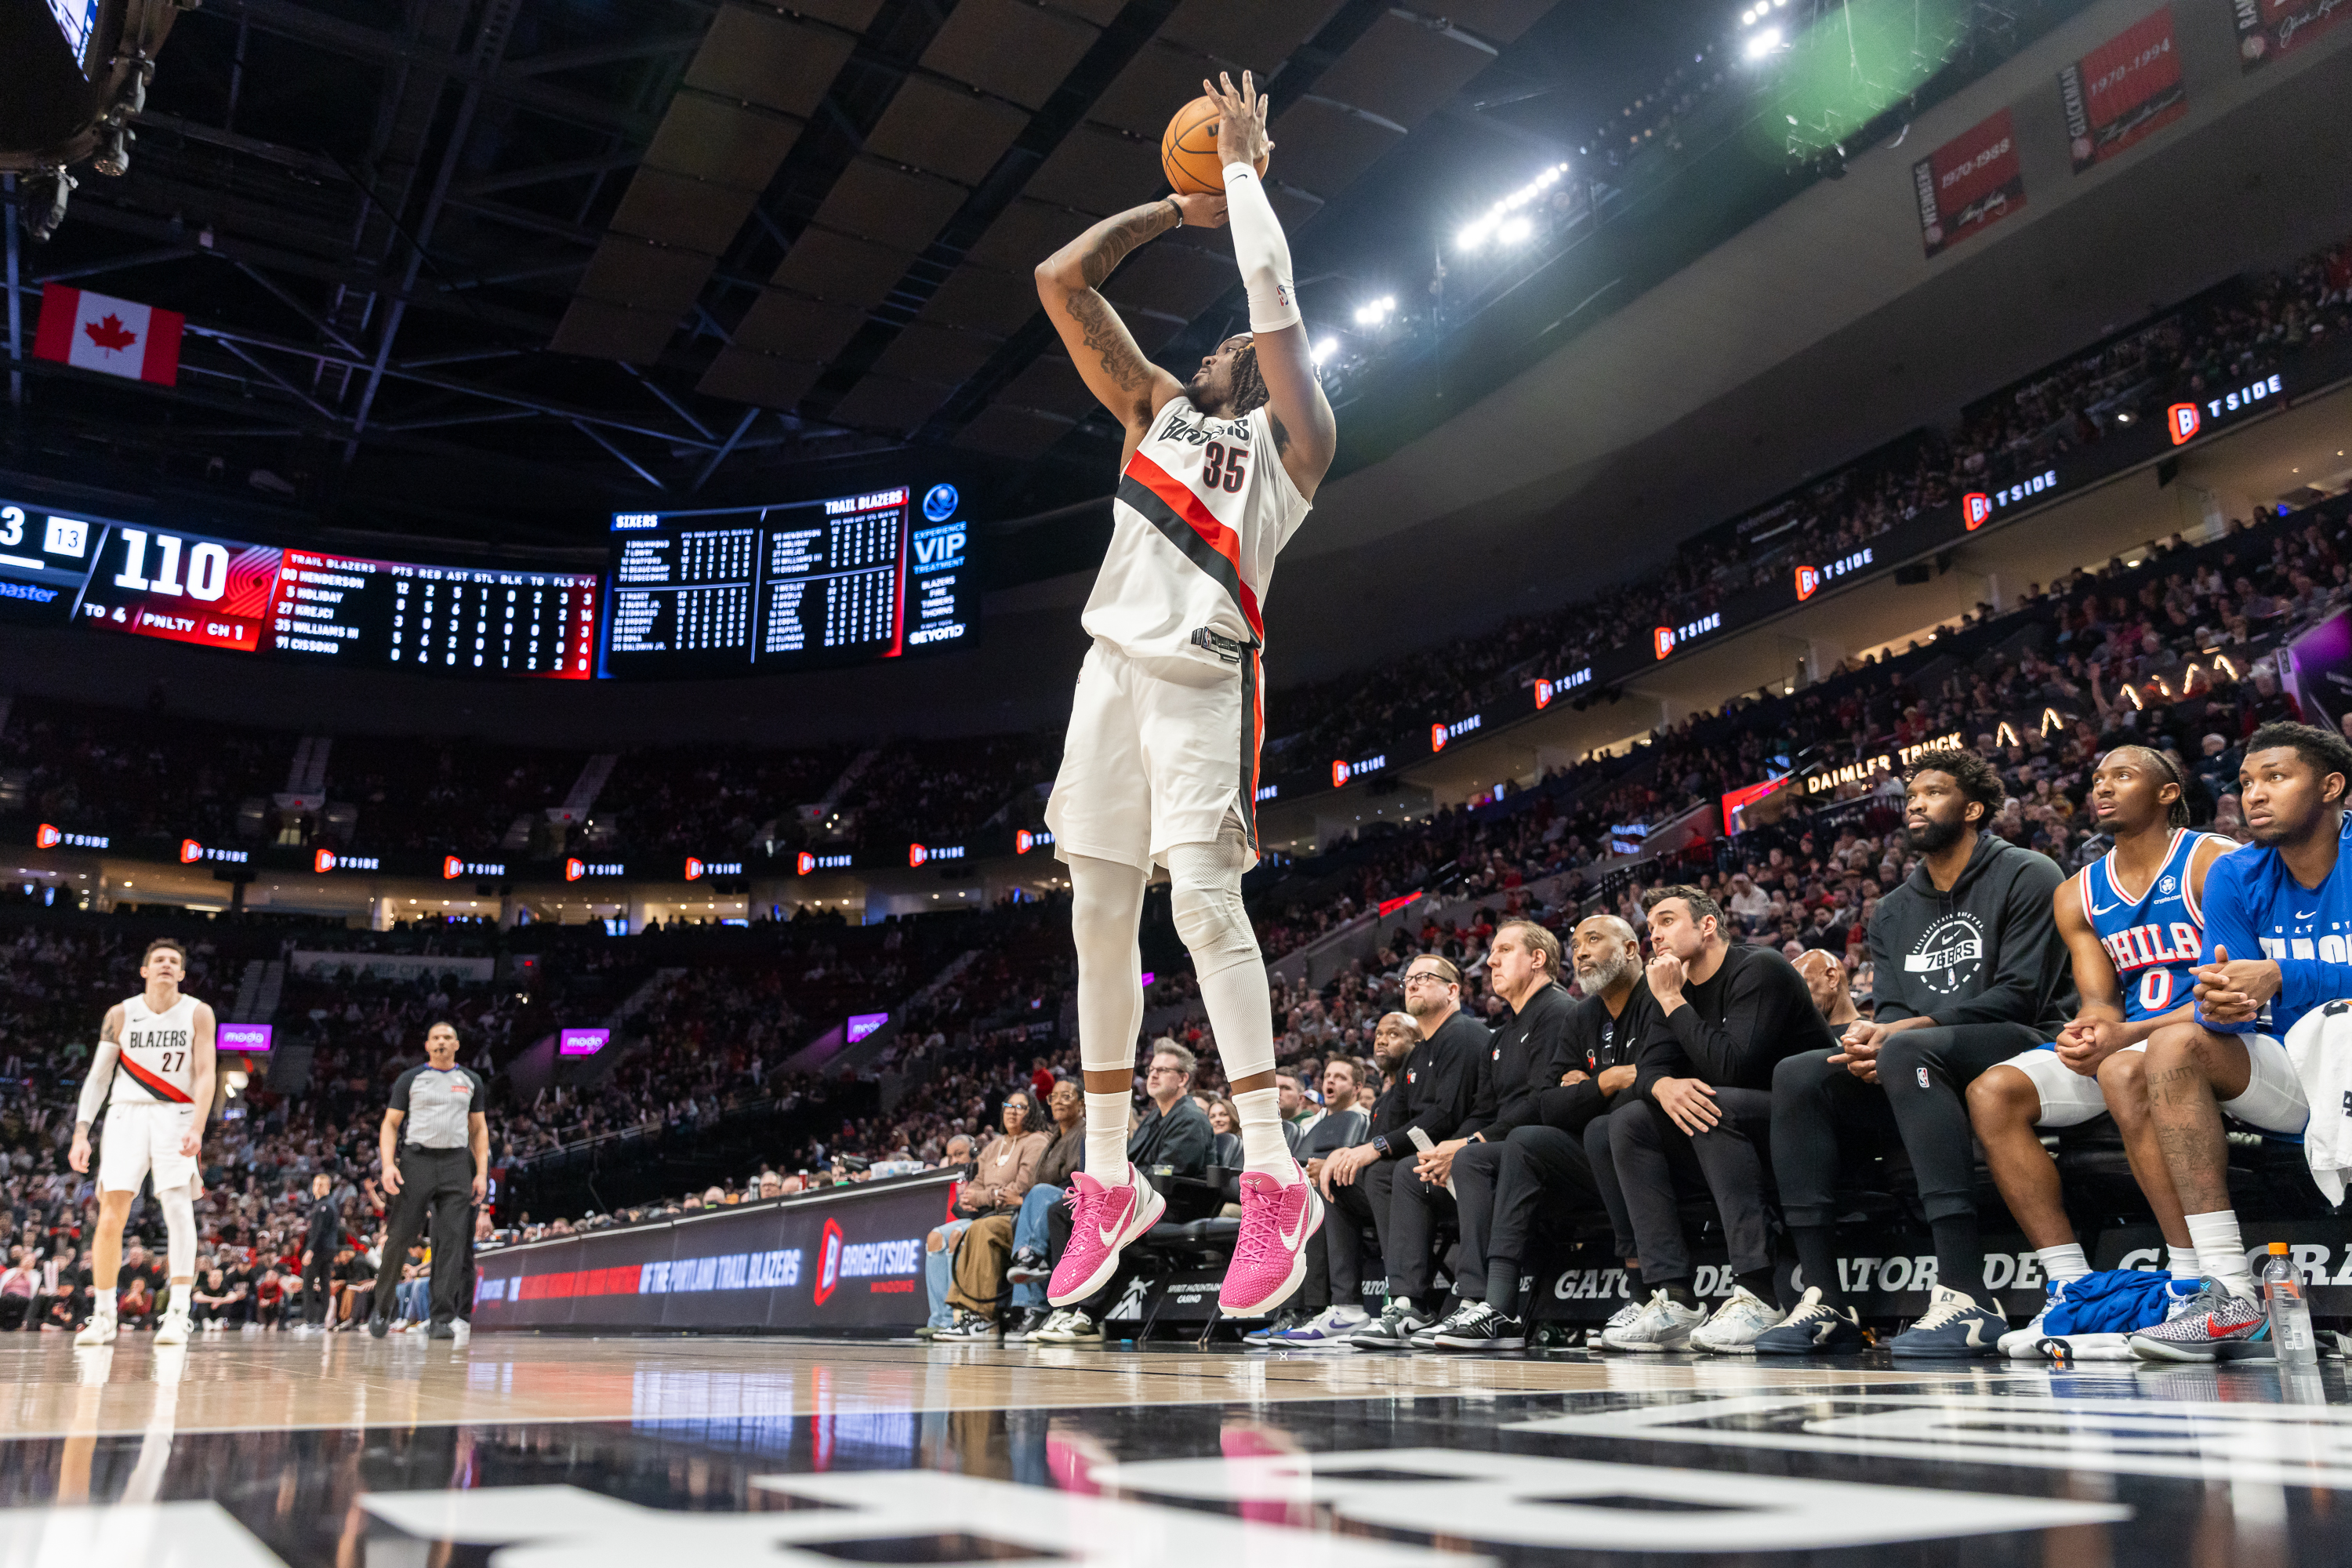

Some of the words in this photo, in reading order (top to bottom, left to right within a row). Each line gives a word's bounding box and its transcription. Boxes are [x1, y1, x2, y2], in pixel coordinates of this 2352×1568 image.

[1158, 416, 1250, 445] BLAZS
[1203, 441, 1249, 493] 35
[825, 499, 856, 514] TRAIL
[858, 490, 903, 510] BLAZERS
[616, 514, 658, 528] SIXERS
[913, 521, 967, 540] EXPERIENCE
[57, 528, 78, 548] 13
[913, 532, 967, 564] VIP
[114, 528, 229, 602] 110
[913, 555, 965, 575] TREATMENT
[391, 566, 413, 577] PTS
[418, 568, 442, 580] REB
[446, 572, 469, 582] AST
[474, 573, 495, 584] STL
[499, 575, 523, 586] BLK
[553, 577, 575, 587] FLS
[84, 603, 106, 618] TO
[112, 607, 127, 623] 4
[142, 613, 195, 633] PNLTY
[207, 622, 230, 637] CH
[235, 625, 244, 641] 1
[1255, 785, 1277, 801] SIDE
[2154, 894, 2182, 905] crypto.com
[2139, 967, 2173, 1011] 0
[130, 1030, 187, 1048] BLAZERS
[223, 1031, 264, 1044] moda
[162, 1052, 185, 1073] 27
[822, 1233, 839, 1288] B
[840, 1239, 920, 1277] BRIGHTSIDE
[1177, 1294, 1202, 1304] CASINO
